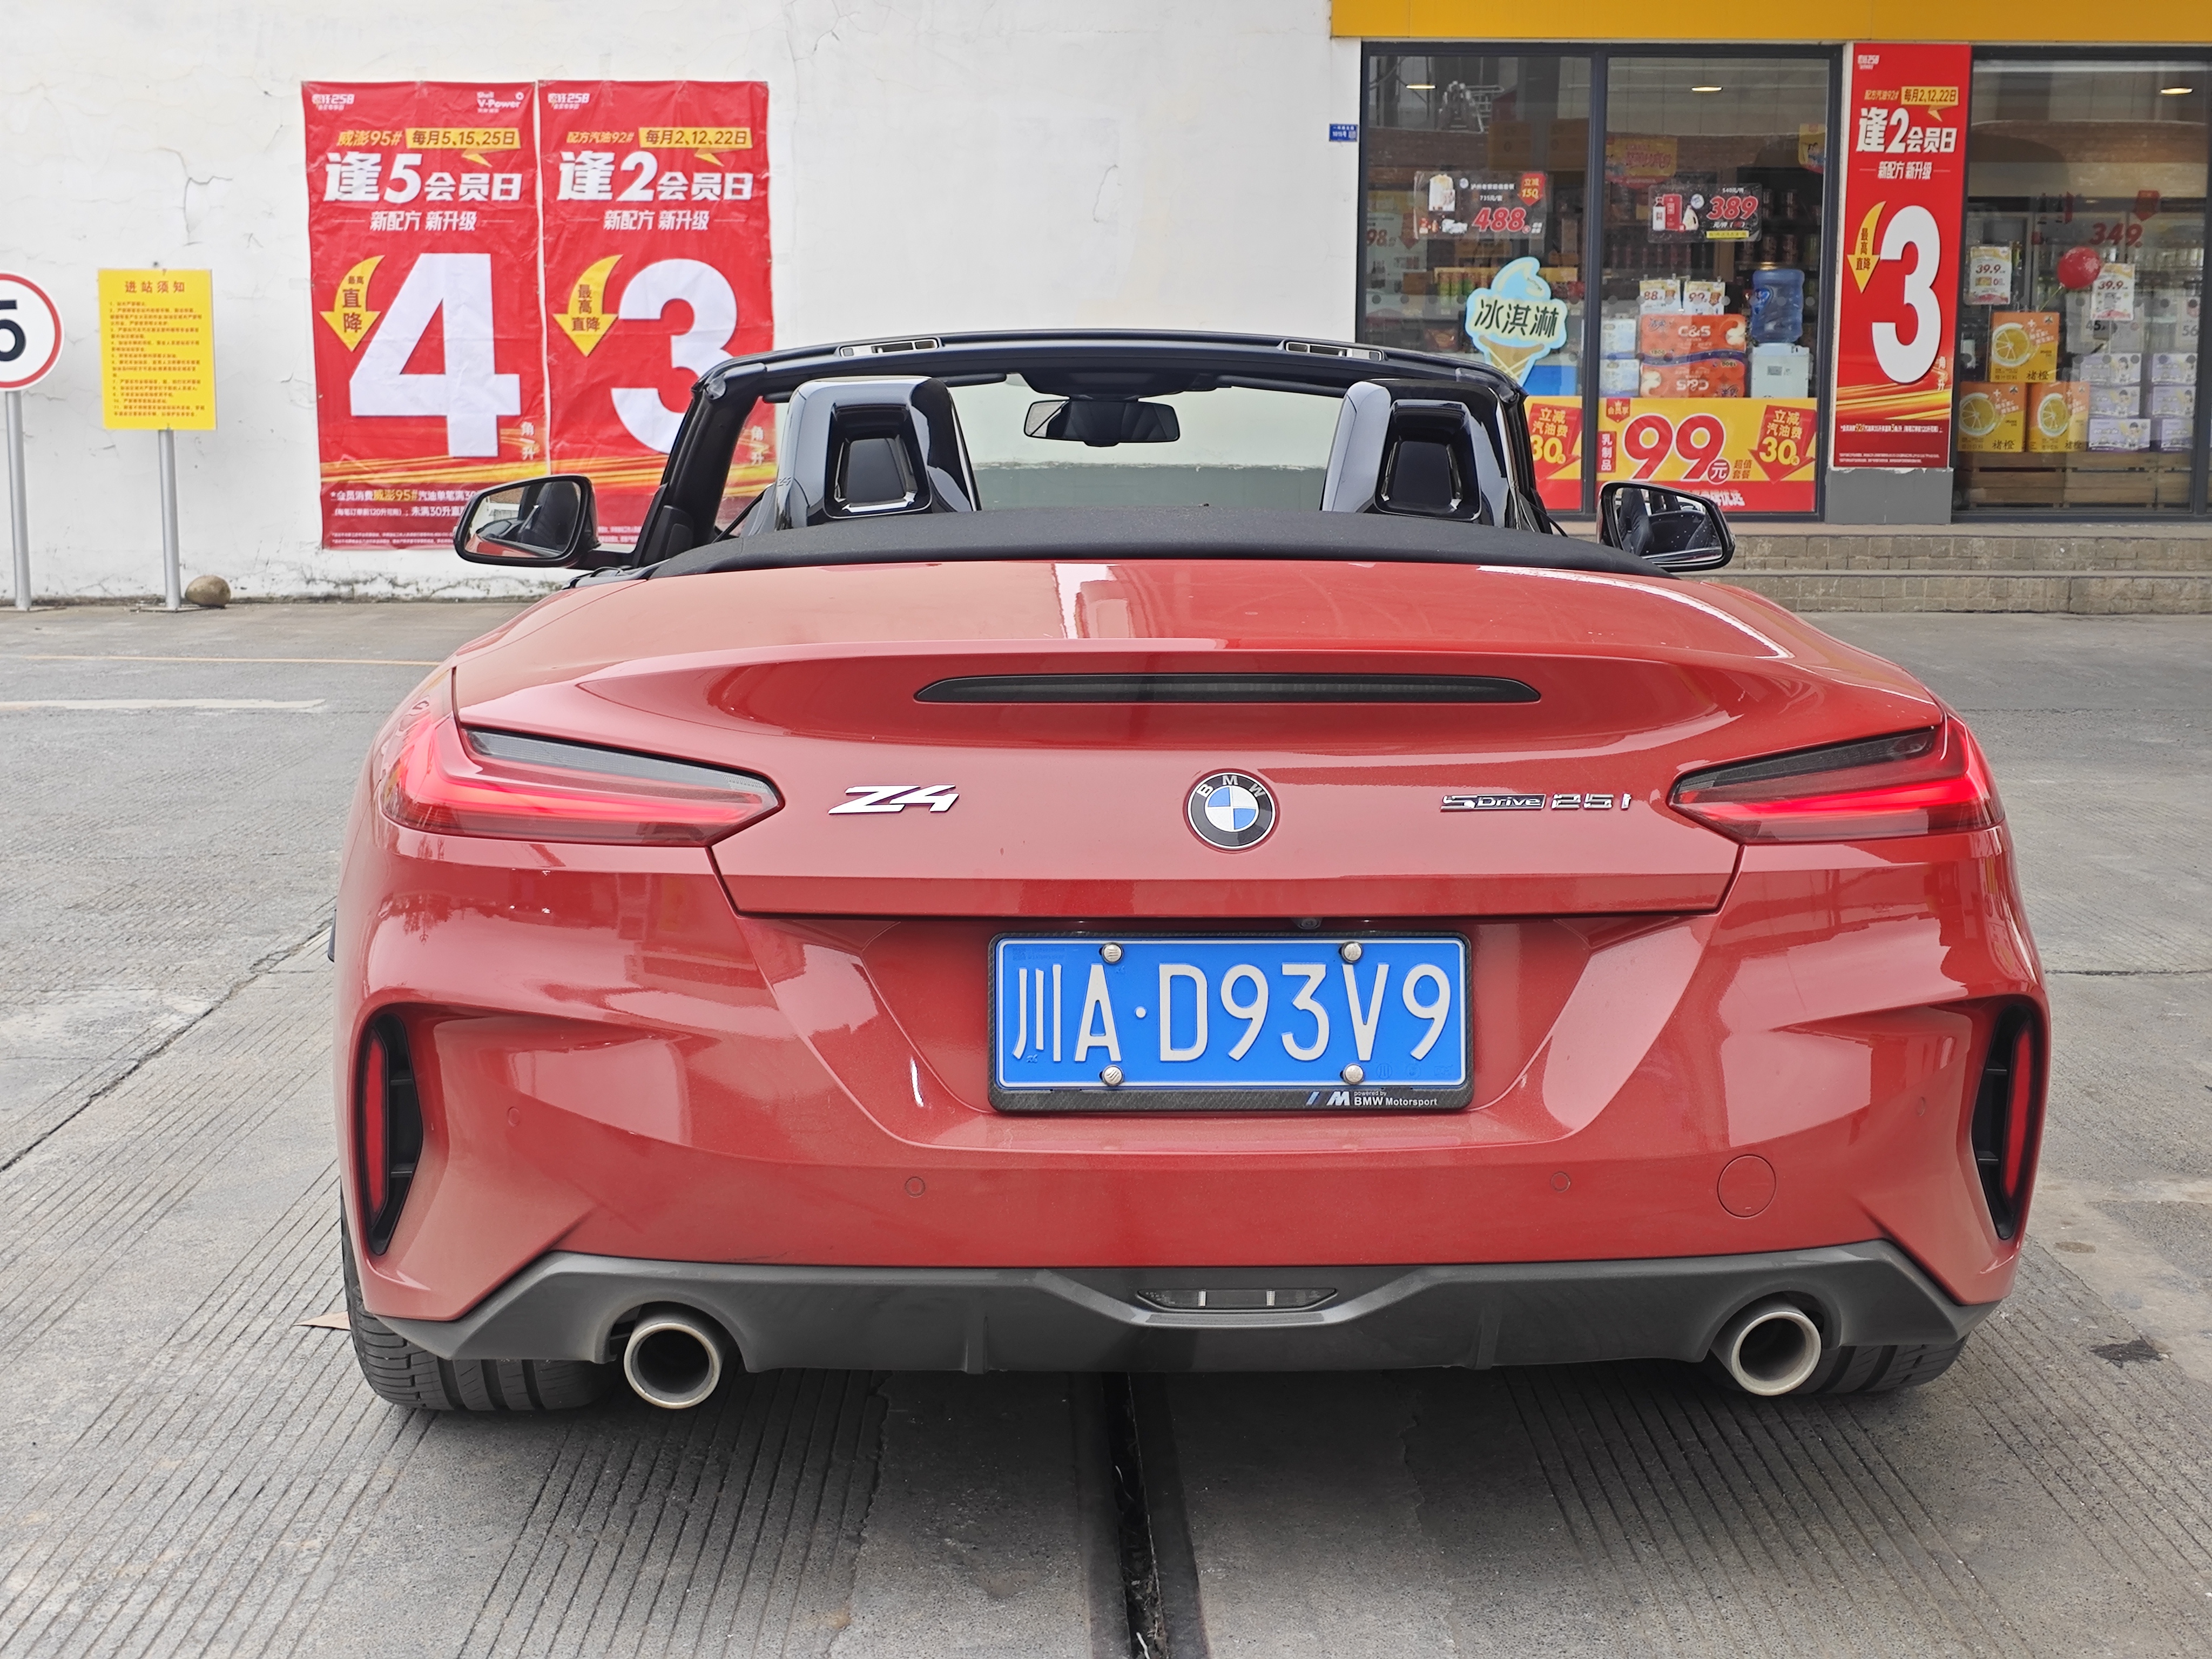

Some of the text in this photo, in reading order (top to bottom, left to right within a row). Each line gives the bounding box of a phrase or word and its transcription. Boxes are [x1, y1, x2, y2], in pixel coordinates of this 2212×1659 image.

[1856, 107, 1958, 153] 逢2会员日
[323, 151, 523, 204] 逢5会员日
[557, 150, 754, 202] 逢2会员日
[1878, 161, 1932, 179] 新配方 新升级
[1472, 207, 1527, 232] 488
[1707, 195, 1758, 220] 389
[370, 211, 477, 231] 新配方 新升级
[604, 210, 710, 231] 新配方 新升级
[125, 281, 185, 293] 进站须知
[578, 284, 592, 314] 最高
[1872, 205, 1941, 384] 3
[342, 287, 362, 334] 直降
[1474, 299, 1560, 339] 冰淇淋
[0, 300, 26, 361] 5
[571, 316, 601, 332] 直降
[1678, 325, 1711, 338] C&S
[349, 253, 522, 457] 4
[611, 258, 738, 455] 3
[1539, 407, 1566, 424] 立减
[1773, 409, 1800, 425] 立减
[1532, 420, 1568, 437] 汽油费
[1766, 423, 1802, 440] 汽油费
[1601, 434, 1613, 470] 乳制品
[1732, 469, 1750, 480] 套餐
[1734, 460, 1752, 470] 超值
[1196, 775, 1266, 798] BMW
[828, 784, 960, 814] Z4
[1326, 1091, 1438, 1107] M BMW Motorsport
